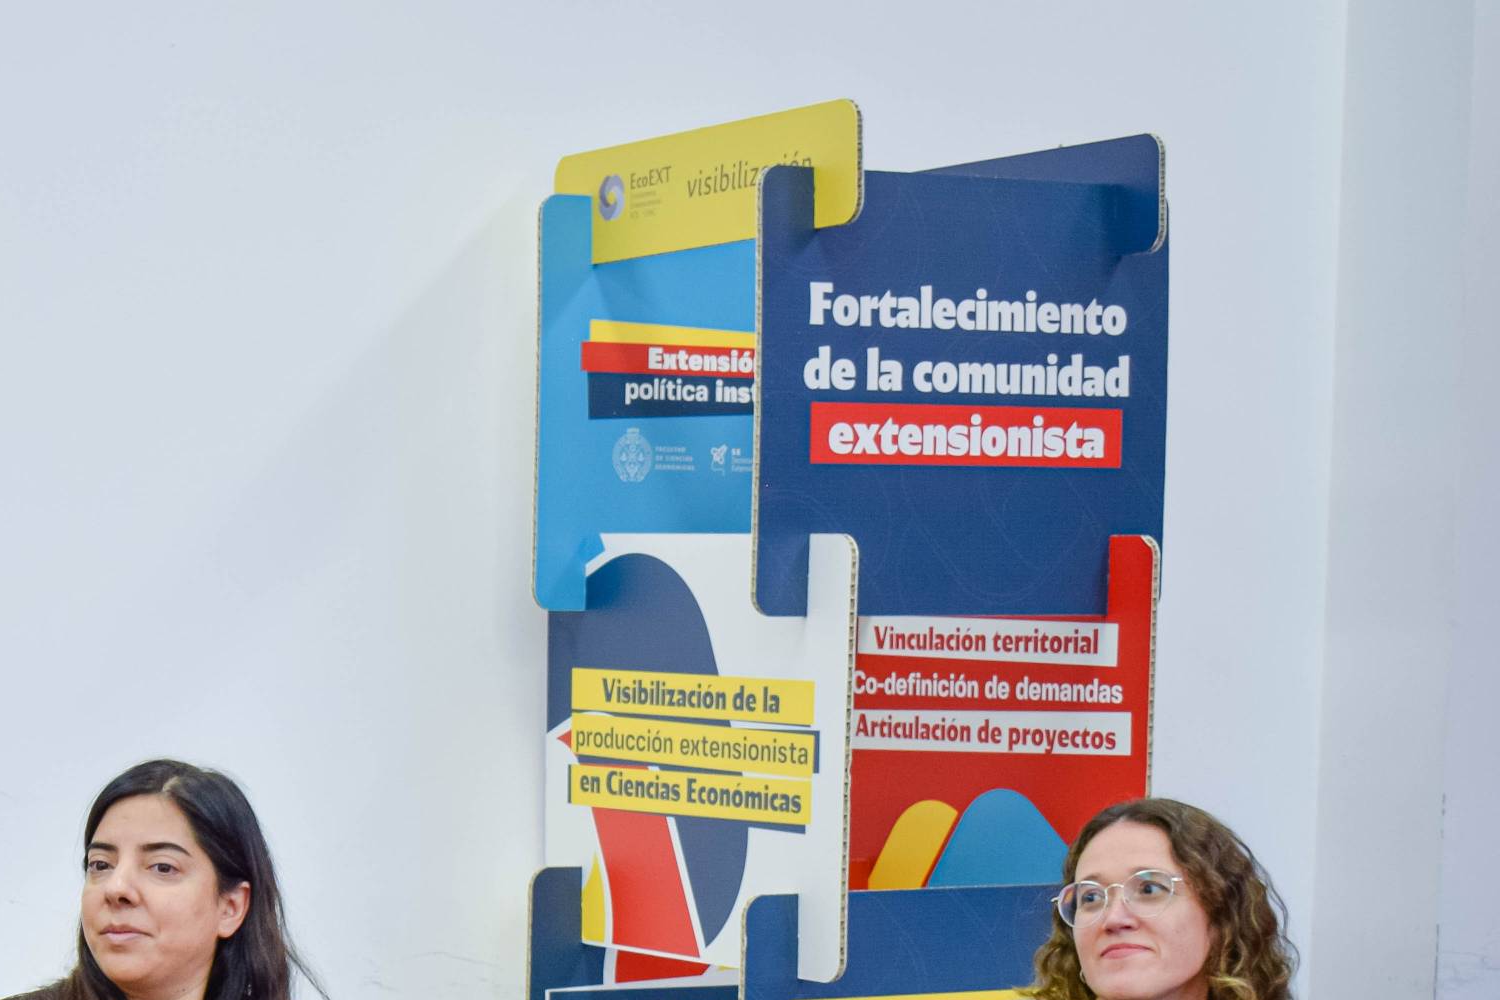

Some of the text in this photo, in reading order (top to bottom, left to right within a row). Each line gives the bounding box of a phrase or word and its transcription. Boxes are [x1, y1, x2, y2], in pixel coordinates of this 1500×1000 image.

[630, 166, 672, 190] EcoEXT
[687, 151, 812, 198] visibiliz
[809, 281, 1127, 336] Fortalecimiento
[648, 347, 755, 374] Extensió
[803, 345, 1130, 397] de la comunidad
[625, 377, 709, 405] política
[828, 413, 1105, 459] extensionista
[874, 625, 1099, 654] Vinculación territorial
[602, 678, 780, 713] Visibilización de la
[852, 670, 1123, 704] Co-definición de demandas
[575, 727, 808, 765] producción extensionista
[855, 713, 1116, 754] Articulación de proyectos
[579, 770, 802, 814] en Ciencias Económicas
